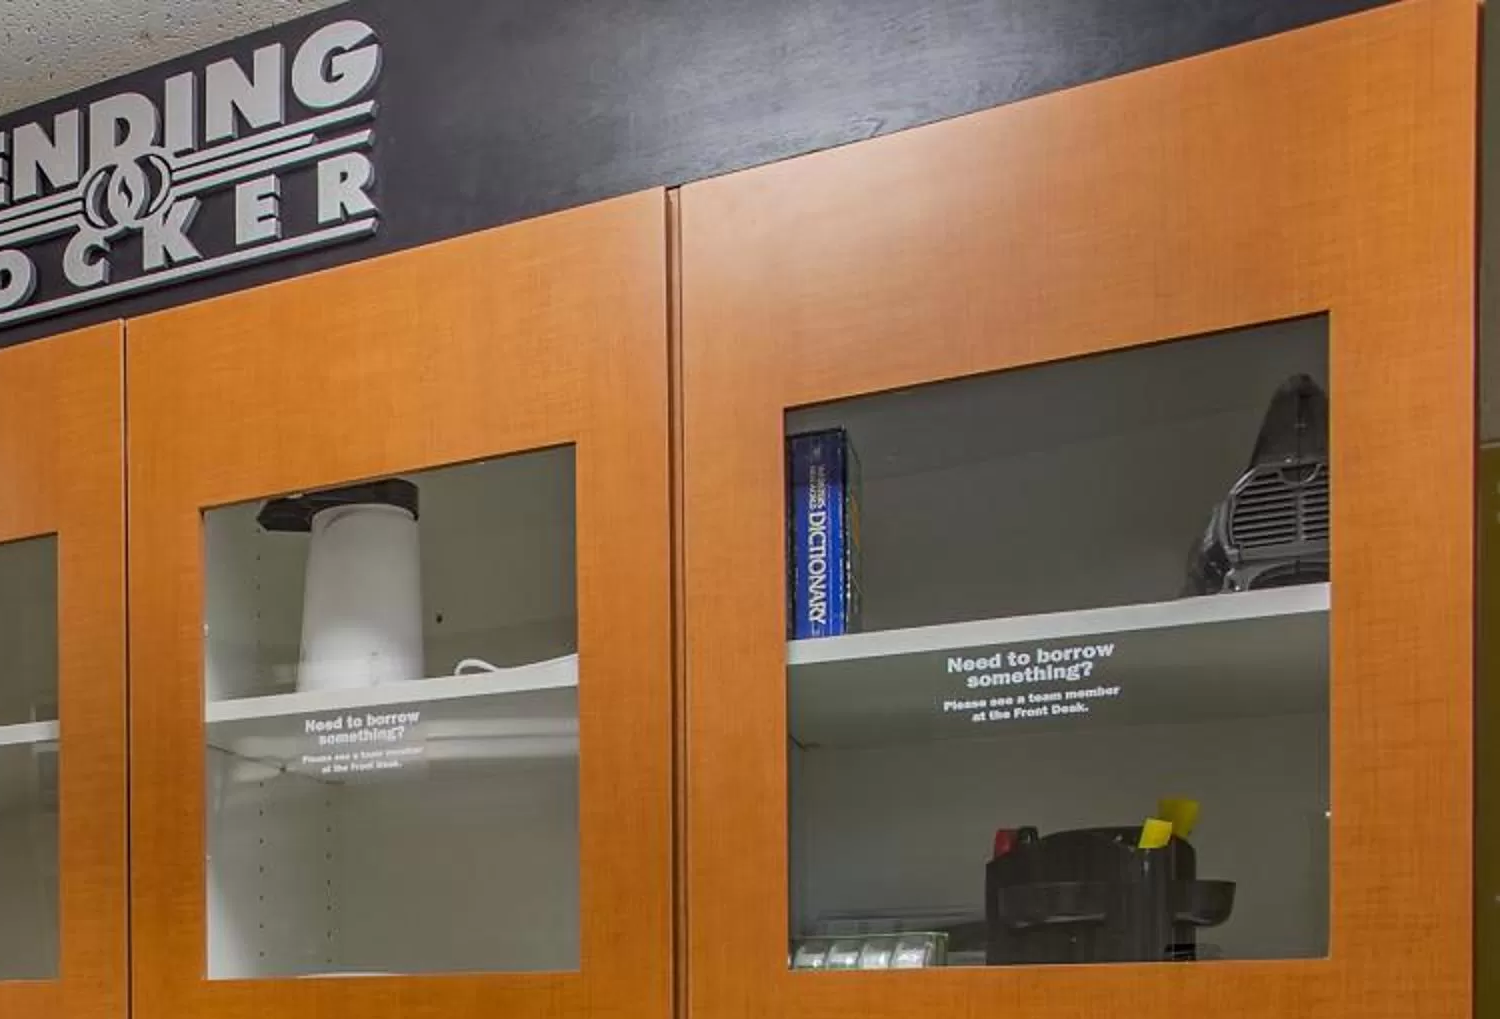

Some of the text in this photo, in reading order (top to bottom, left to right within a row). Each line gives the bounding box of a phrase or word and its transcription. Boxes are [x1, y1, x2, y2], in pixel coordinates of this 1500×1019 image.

[808, 511, 827, 624] DICTIONARY
[947, 643, 1115, 673] Need to borrow
[966, 661, 1093, 689] something?
[943, 700, 987, 712] Please
[1016, 696, 1025, 704] a
[1028, 693, 1062, 703] team
[1065, 686, 1121, 700] member
[971, 702, 1089, 722] at the Front Desk.
[305, 711, 420, 733] Need to borrow
